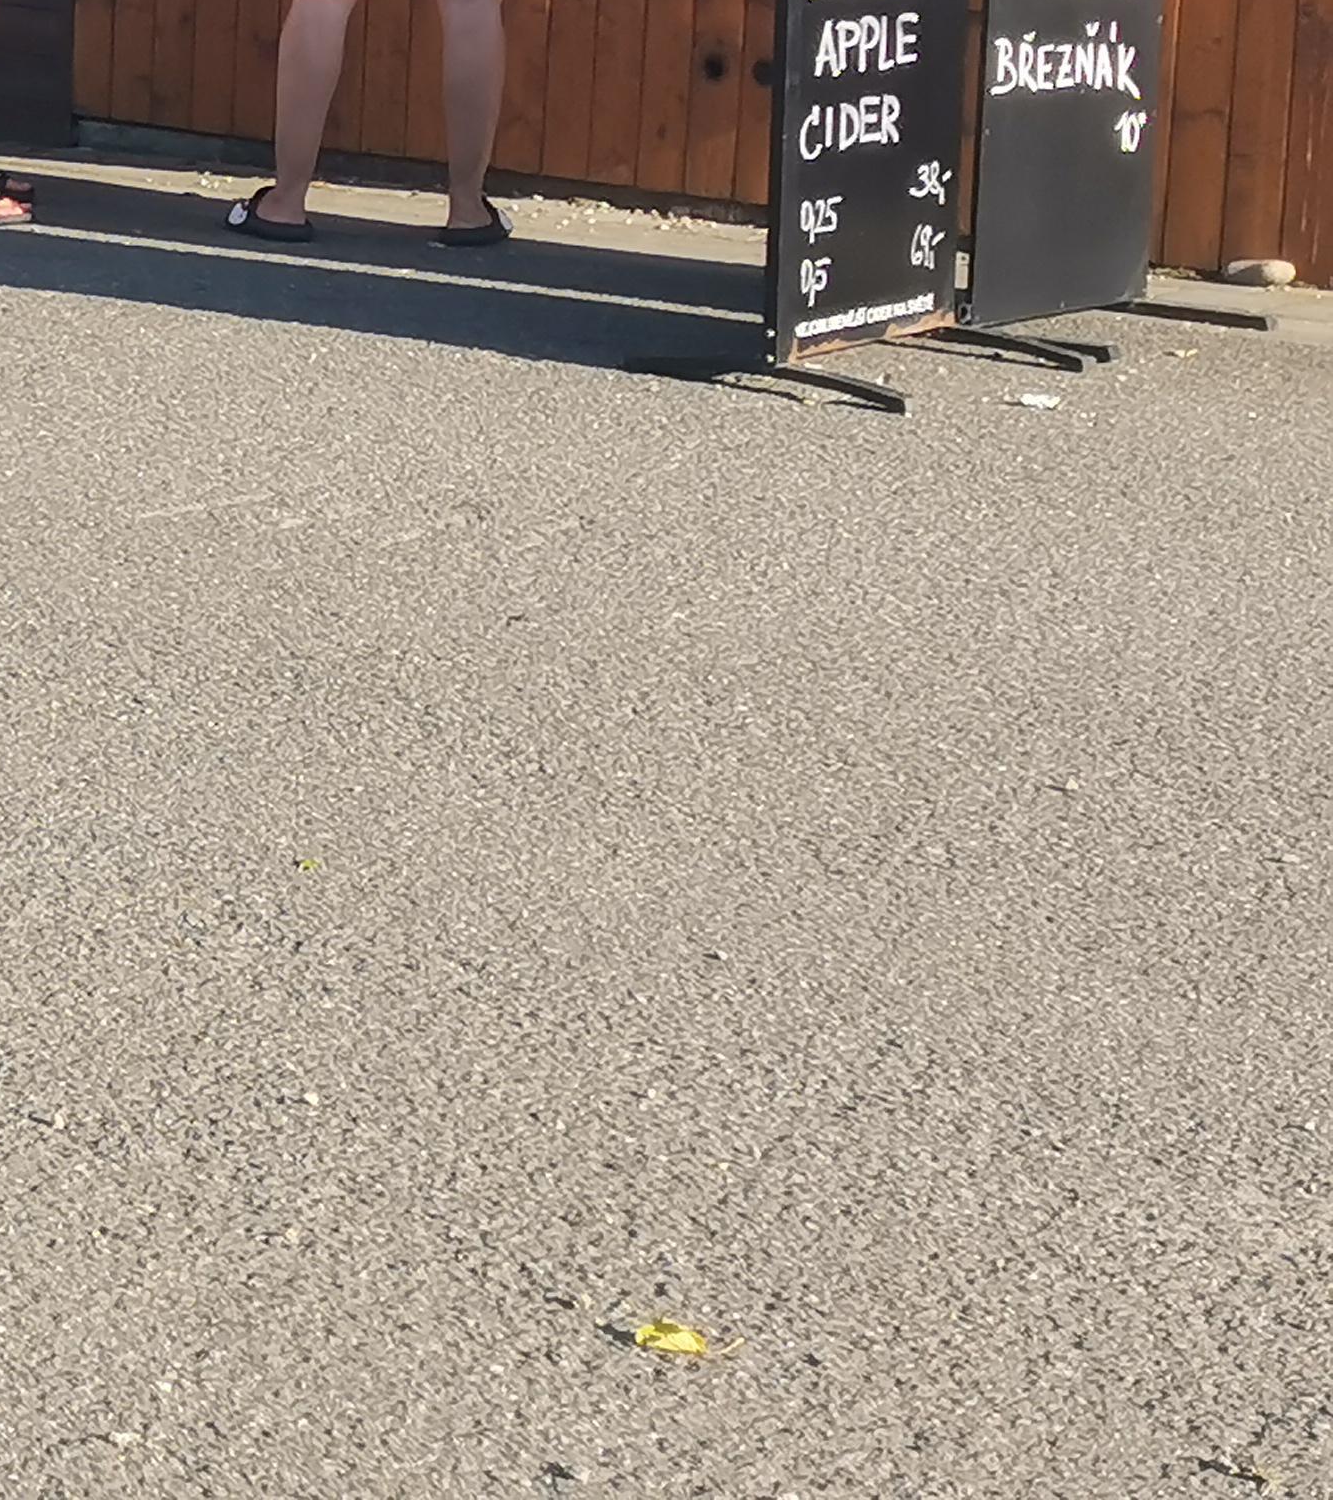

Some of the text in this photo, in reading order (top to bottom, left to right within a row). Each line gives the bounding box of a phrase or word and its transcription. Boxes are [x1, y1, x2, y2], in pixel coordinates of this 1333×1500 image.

[814, 12, 920, 77] APPLE
[989, 21, 1141, 99] BŘEZŇÁK
[799, 94, 901, 160] CIDER
